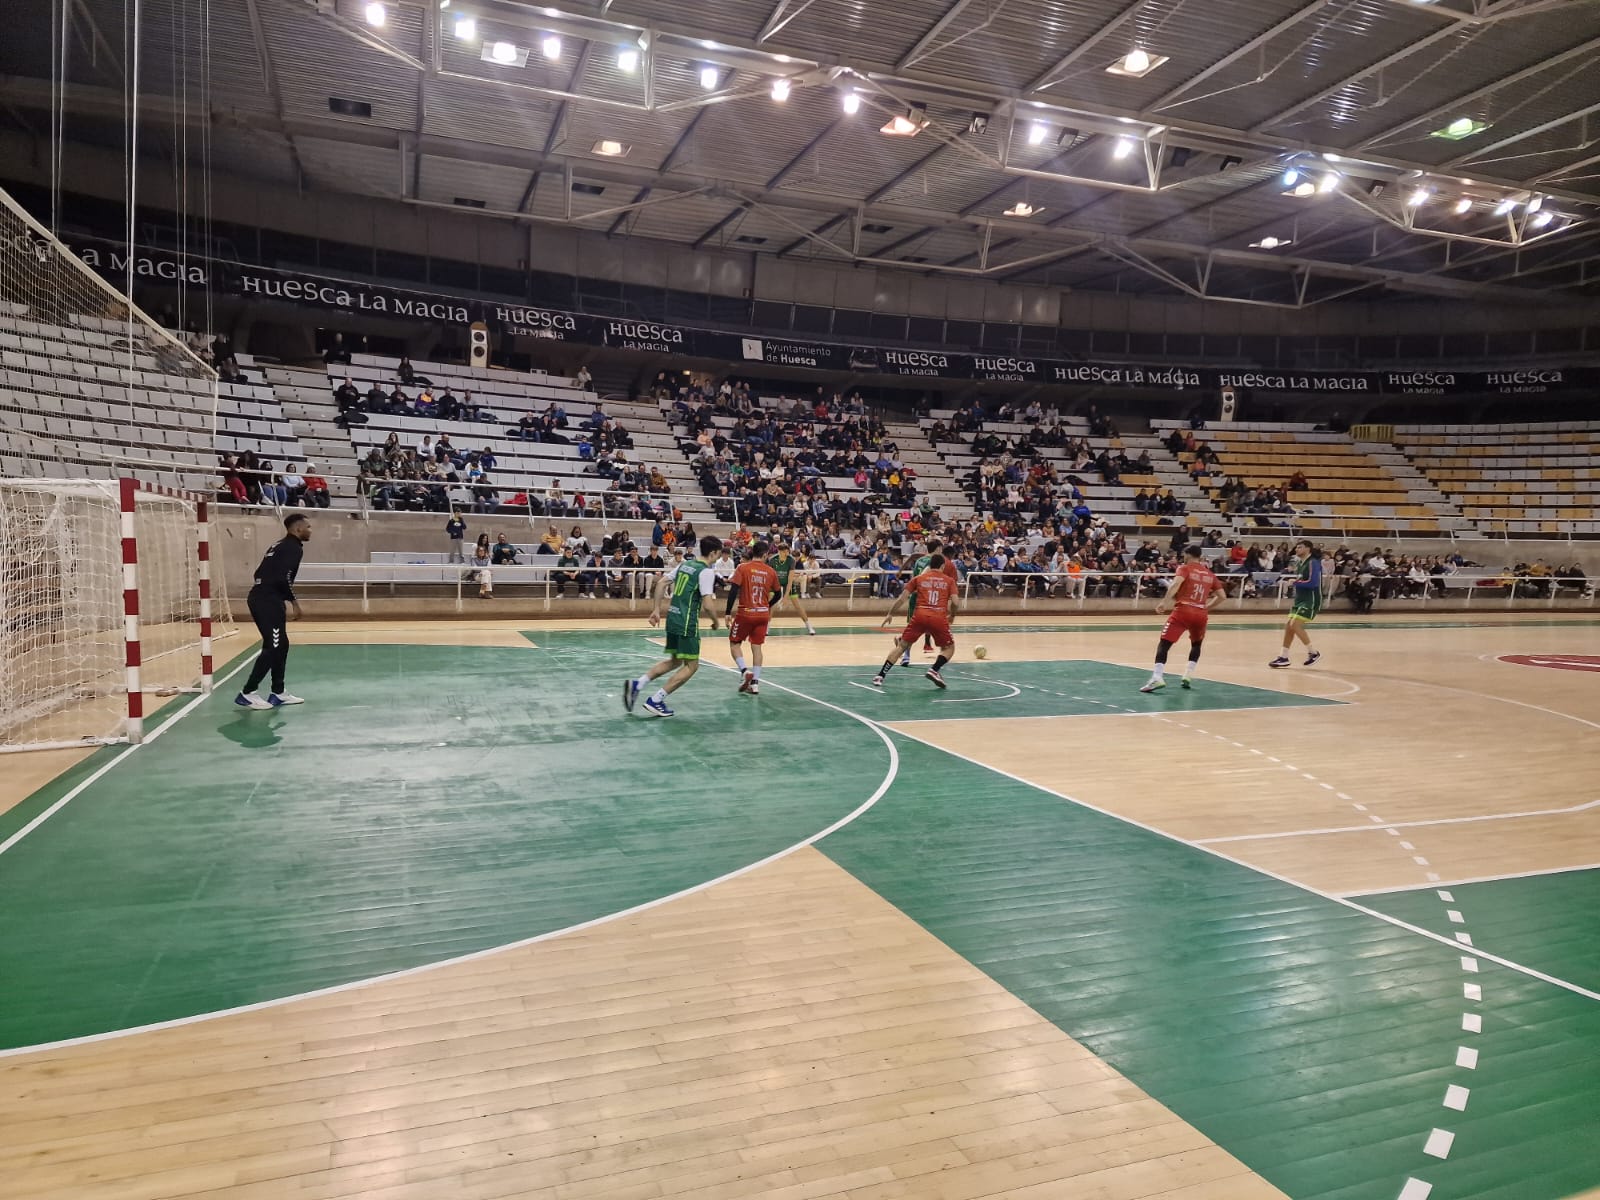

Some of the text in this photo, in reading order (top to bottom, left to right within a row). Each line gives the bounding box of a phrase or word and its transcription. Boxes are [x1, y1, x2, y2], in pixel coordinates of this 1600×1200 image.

[359, 293, 388, 312] La
[765, 341, 831, 357] Ayuntamiento
[766, 353, 817, 366] de Huesca
[331, 523, 342, 540] 3
[673, 571, 690, 597] 10
[927, 590, 939, 606] 10
